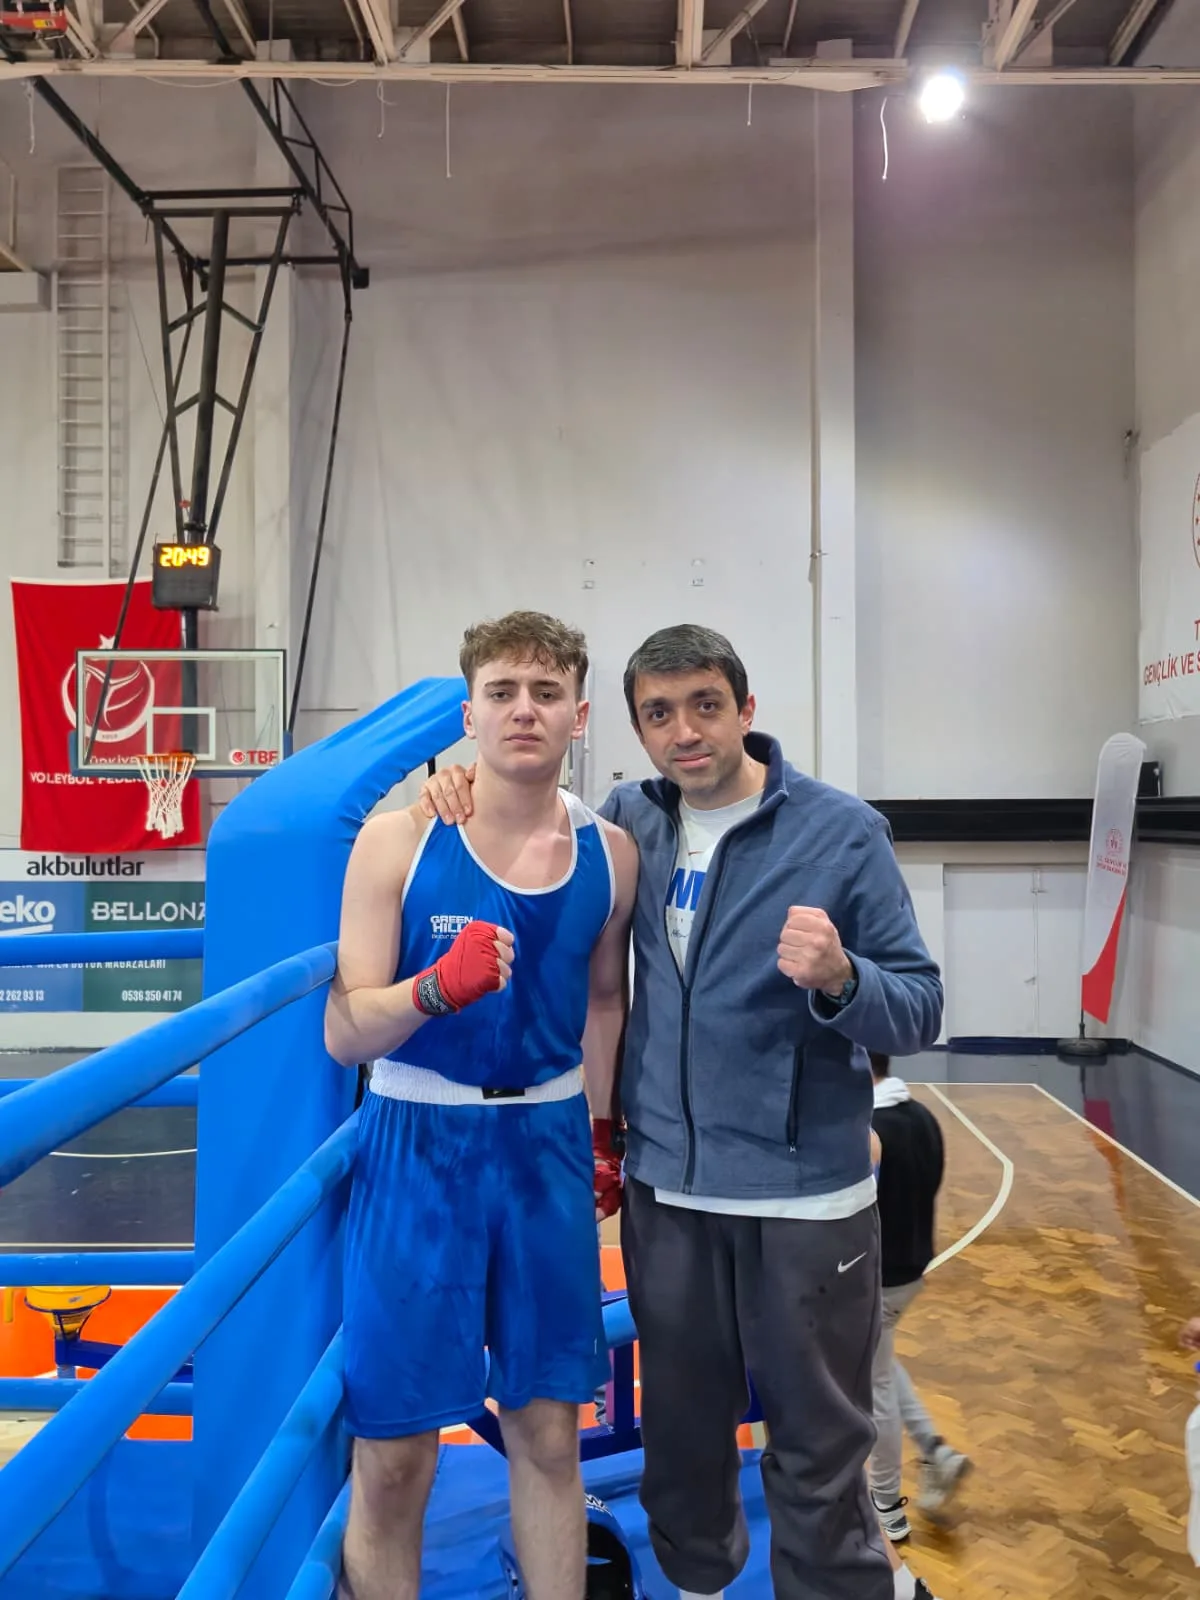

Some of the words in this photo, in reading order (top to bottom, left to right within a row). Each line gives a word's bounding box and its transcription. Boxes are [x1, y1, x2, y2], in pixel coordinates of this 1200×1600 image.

[1143, 653, 1178, 686] GENÇLİK
[1181, 653, 1194, 675] VE
[247, 750, 279, 765] TBF
[26, 856, 144, 876] akbulutlar
[430, 915, 474, 924] GREEN
